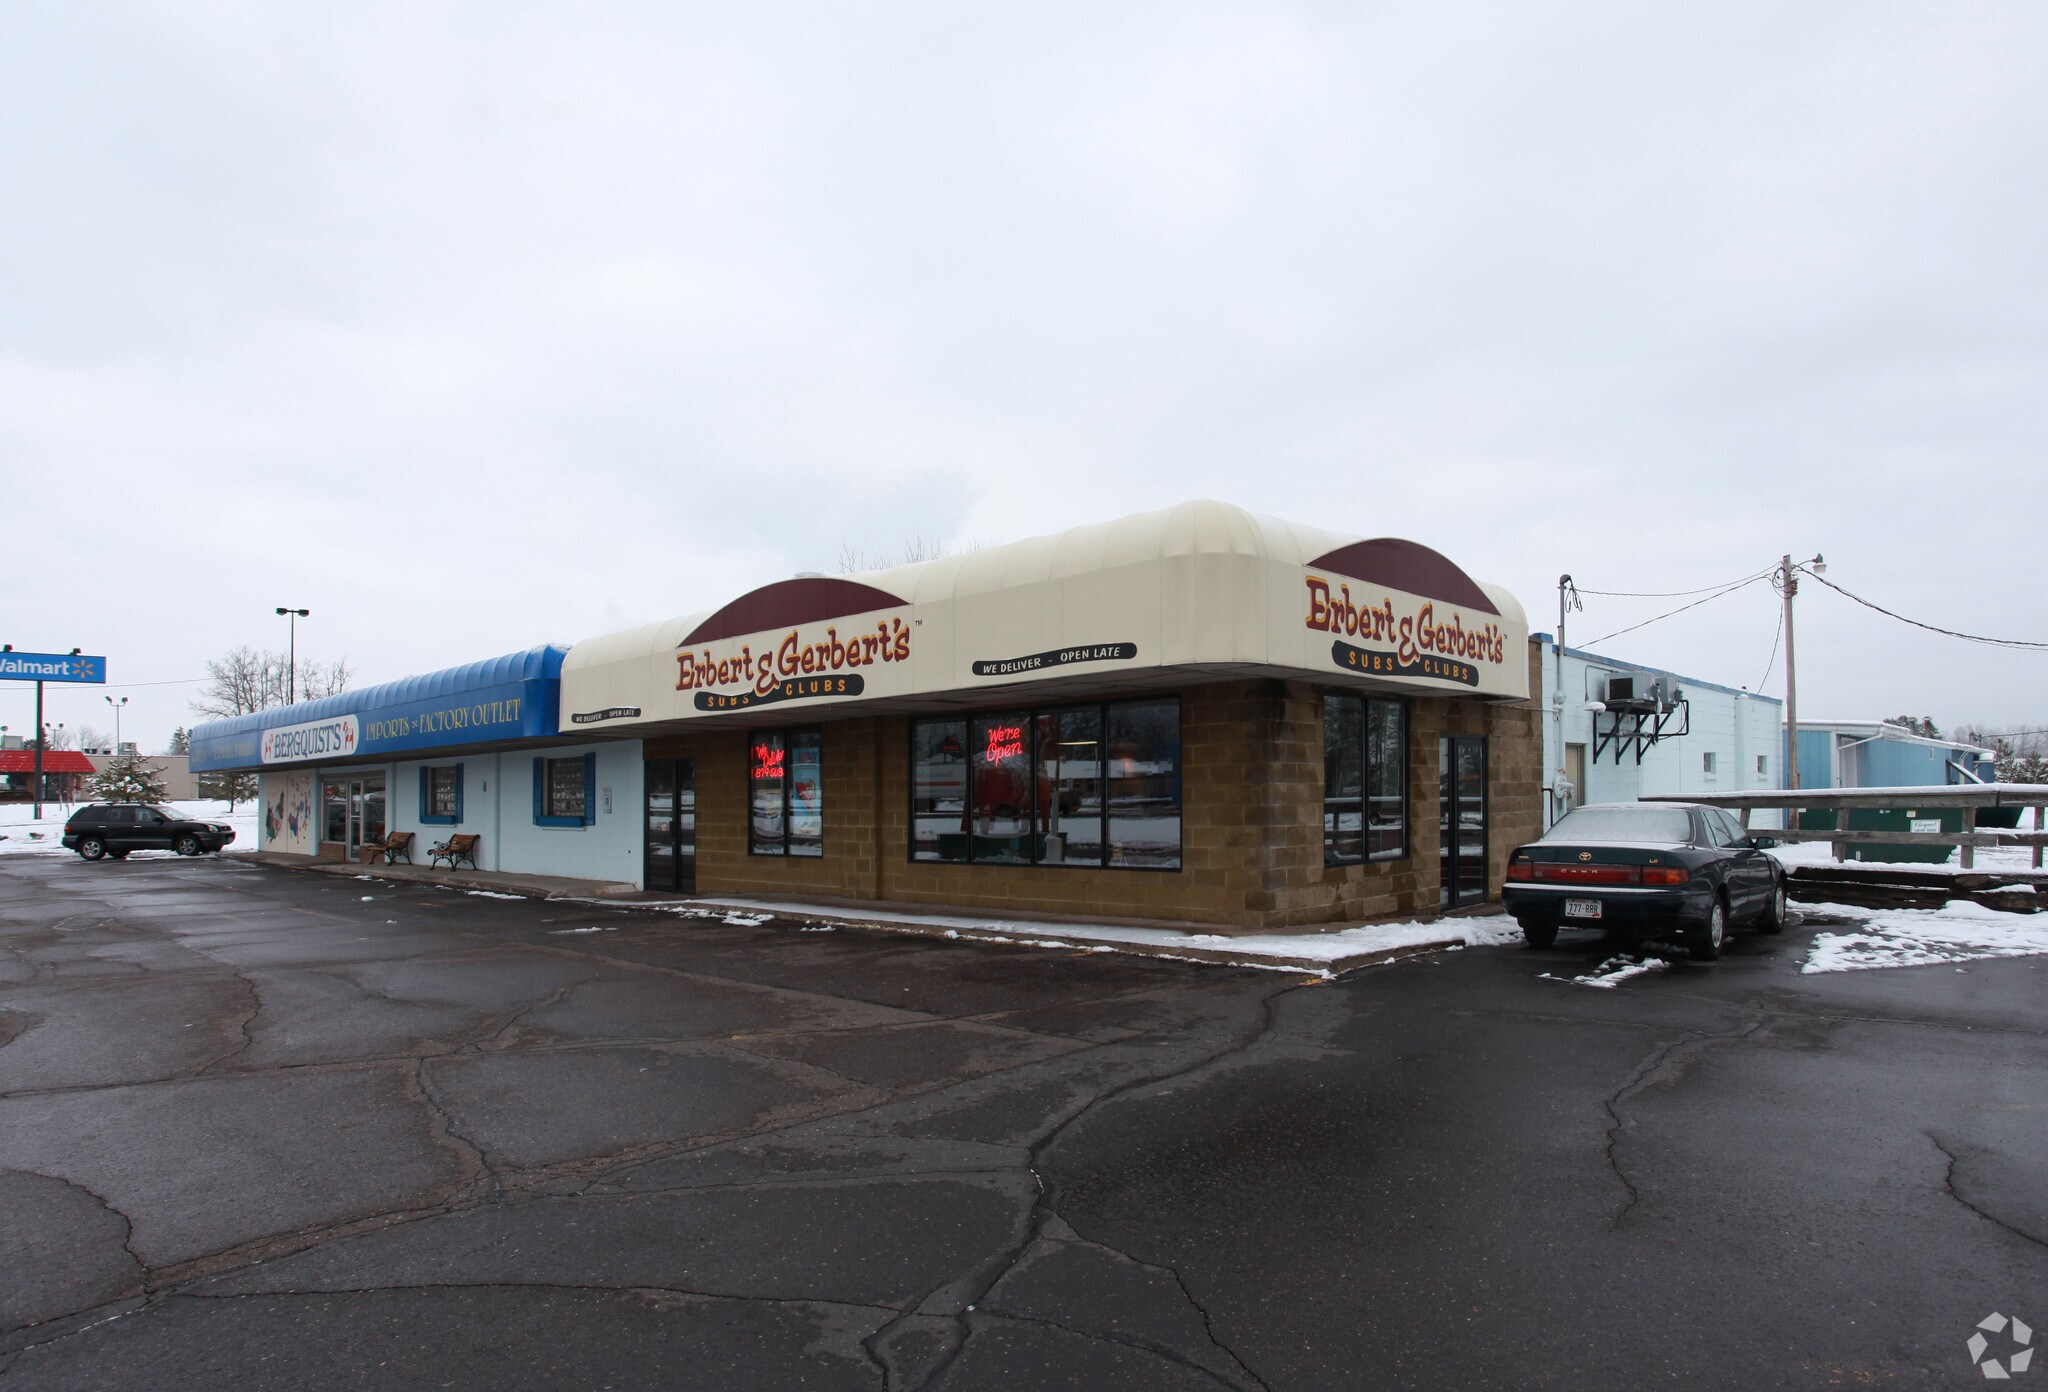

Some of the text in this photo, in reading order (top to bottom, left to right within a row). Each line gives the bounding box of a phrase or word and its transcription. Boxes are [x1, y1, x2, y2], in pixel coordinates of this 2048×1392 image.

[1305, 575, 1503, 664] Erbert & Gerbert's
[675, 644, 754, 691] Erbert
[755, 650, 780, 696] &
[777, 616, 911, 677] Gerbert's
[983, 664, 997, 674] WE
[1000, 657, 1042, 673] DELIVER
[1060, 649, 1090, 662] OPEN
[1093, 646, 1121, 658] LATE
[1348, 650, 1469, 681] SUBS CLUBS
[707, 678, 846, 707] SUBS CLUBS
[366, 717, 410, 741] IMPORTS
[419, 706, 470, 734] FACTORY
[472, 698, 521, 726] OUTLET
[583, 714, 602, 722] DELIVER
[609, 709, 623, 717] OPEN
[274, 723, 341, 759] BERGQUIST'S
[755, 742, 768, 760] We
[986, 741, 1023, 767] Open
